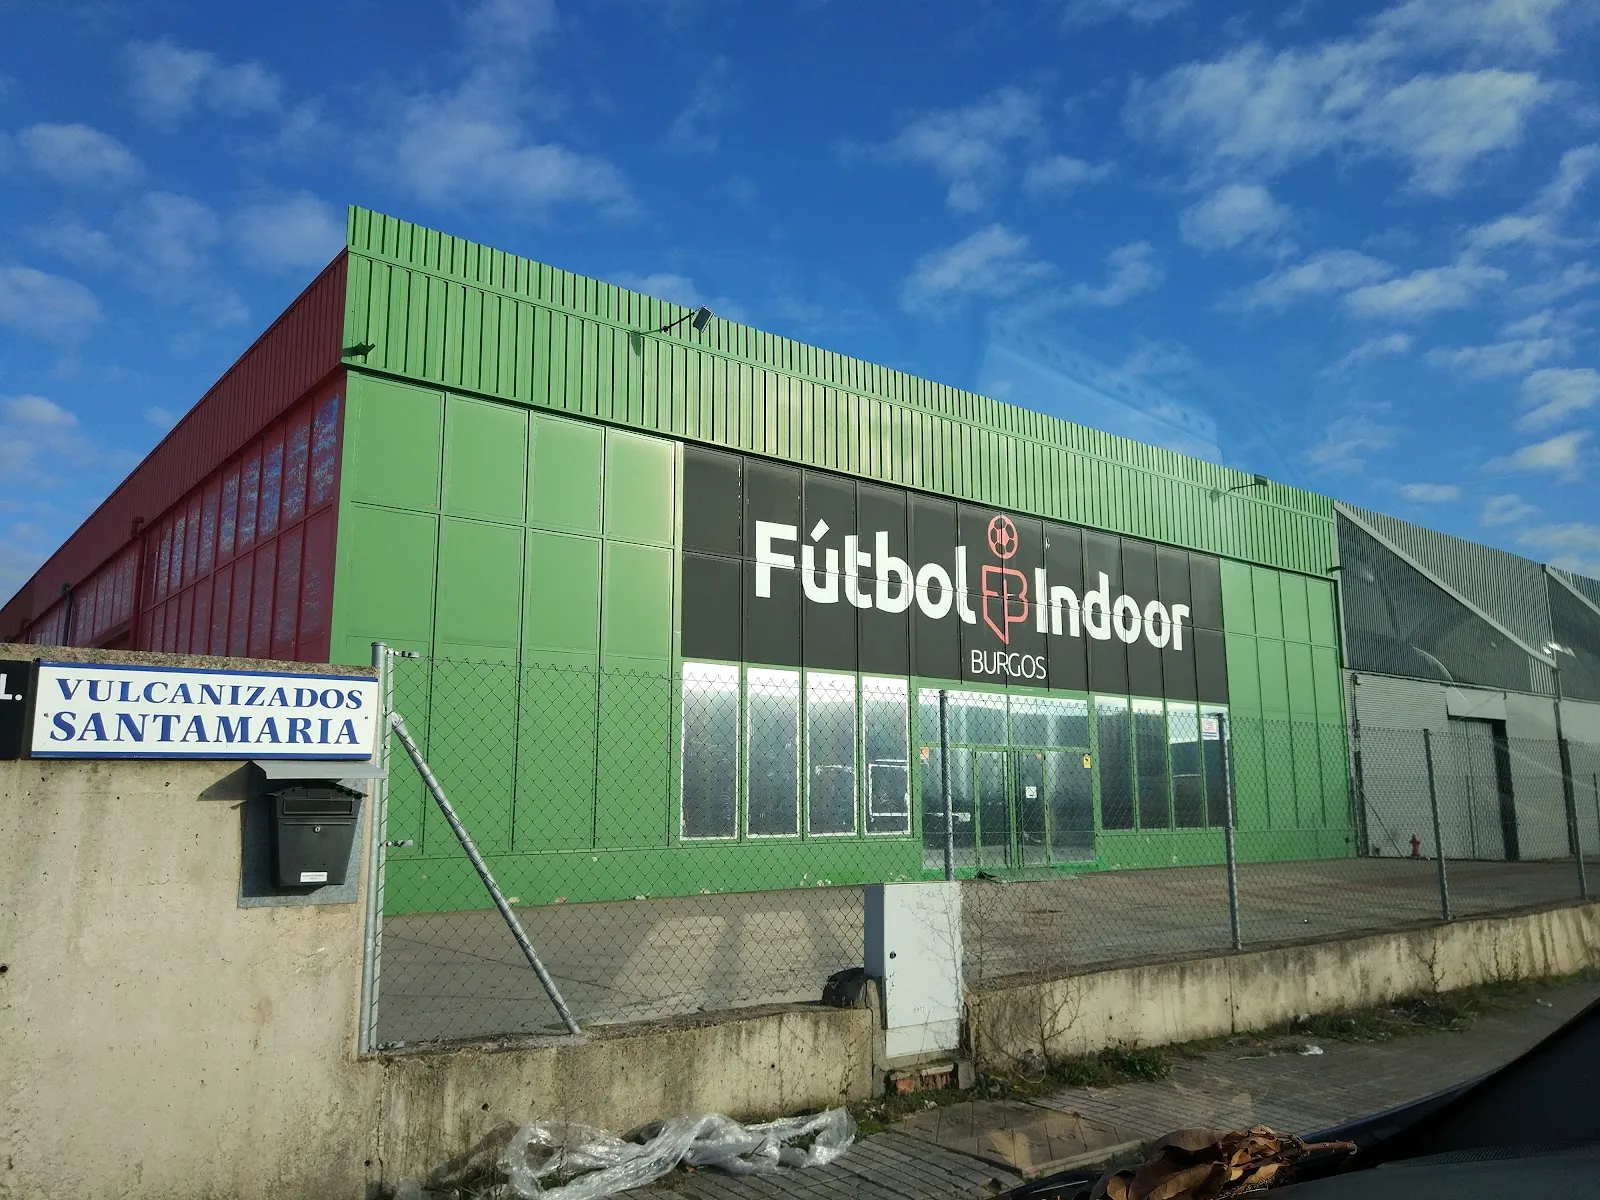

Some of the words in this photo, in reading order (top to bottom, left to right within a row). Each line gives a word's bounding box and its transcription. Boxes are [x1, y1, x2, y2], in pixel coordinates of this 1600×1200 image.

[754, 518, 977, 624] Fútbol
[1034, 567, 1190, 651] Indoor
[971, 650, 1047, 680] BURGOS
[56, 678, 363, 709] VULCANIZADOS
[50, 711, 360, 744] SANTAMARIA
